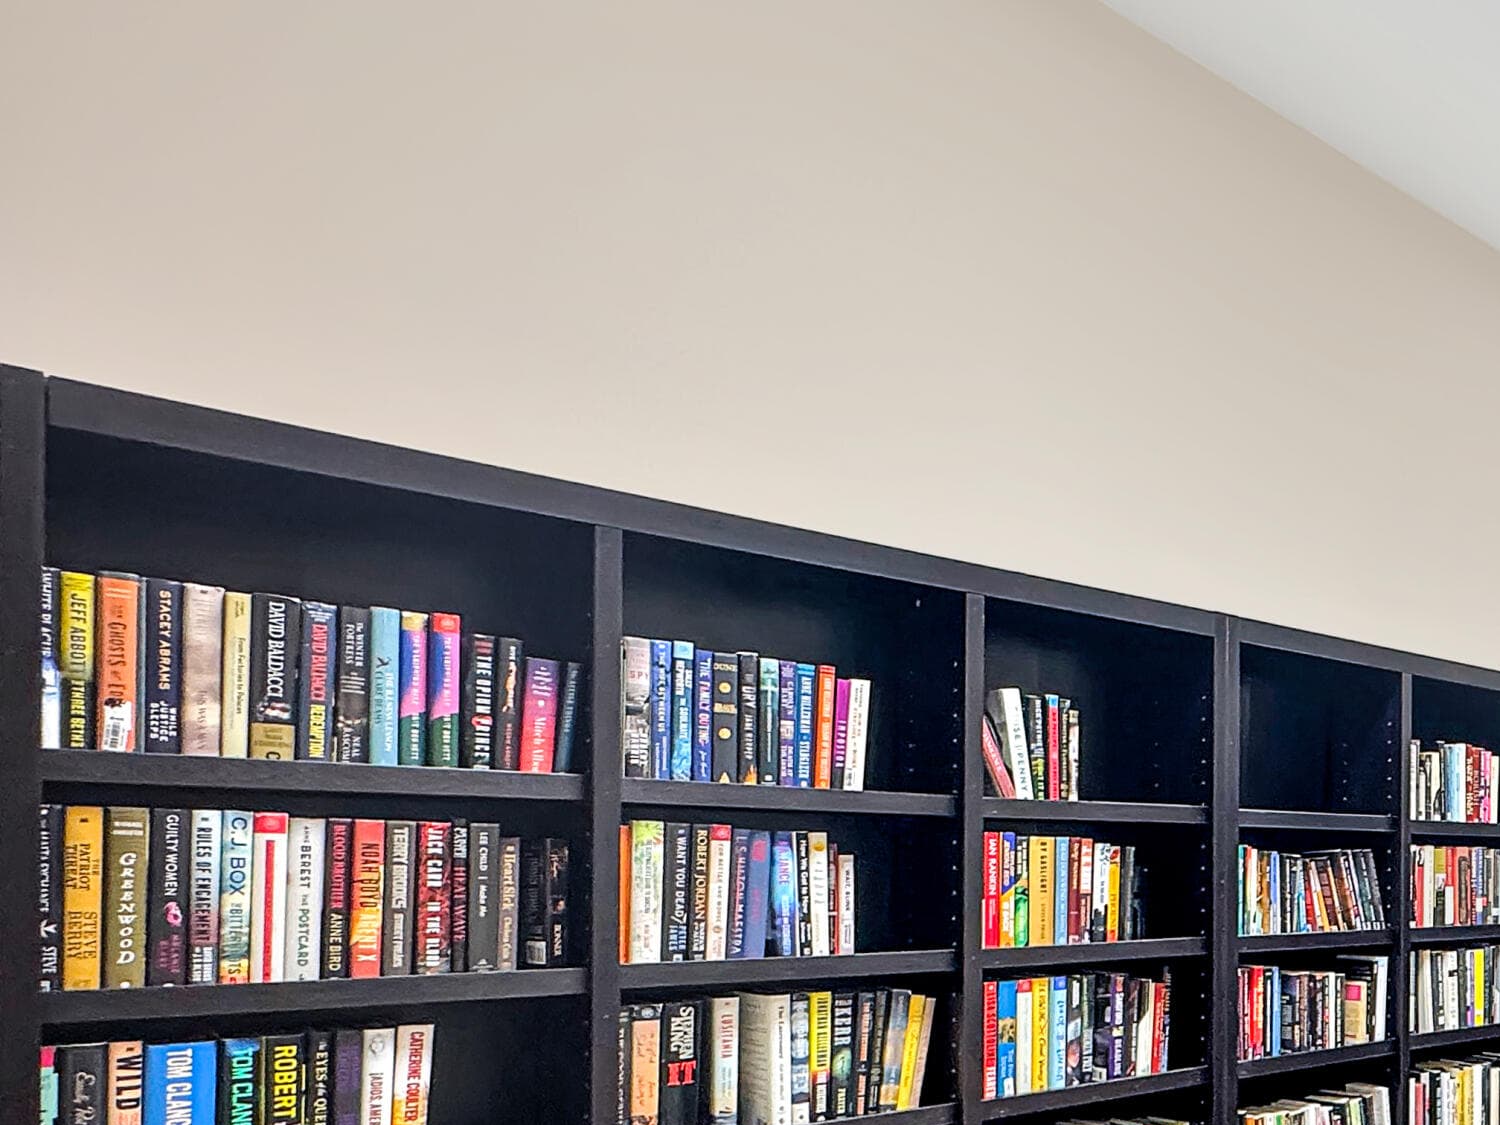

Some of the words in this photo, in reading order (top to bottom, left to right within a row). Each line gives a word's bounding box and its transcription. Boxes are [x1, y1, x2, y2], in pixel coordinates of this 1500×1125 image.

[72, 593, 87, 624] JEFF
[159, 590, 171, 637] STACEY
[269, 602, 285, 638] DAVID
[70, 627, 86, 675] ABBOTT
[108, 622, 126, 666] GHOSTS
[236, 638, 246, 652] From
[312, 624, 327, 652] DAVID
[345, 624, 354, 664] FORTRESS
[355, 633, 364, 666] WINTER
[159, 640, 171, 689] ABRAMS
[236, 655, 245, 682] Factories
[267, 640, 283, 697] BALDACCI
[477, 656, 491, 674] THE
[658, 652, 666, 664] THE
[699, 658, 711, 677] THE
[312, 655, 327, 700] BALDACCI
[801, 676, 812, 694] ANNE
[71, 686, 85, 714] THREE
[236, 692, 244, 714] Palaces
[476, 679, 491, 713] OPIUM
[698, 681, 710, 711] FAMILY
[741, 686, 755, 708] DRY
[150, 703, 159, 739] SLEEPS
[159, 701, 168, 741] JUSTICE
[311, 705, 325, 757] REDEMPTION
[474, 716, 491, 757] PRINCE
[533, 717, 548, 744] Mitch
[658, 722, 664, 732] US
[698, 713, 710, 745] OUTING
[744, 715, 753, 731] JANE
[743, 733, 753, 760] HARPER
[1017, 753, 1027, 791] PENNY
[166, 815, 179, 851] GUILTY
[197, 827, 212, 857] RULES
[333, 824, 346, 859] BLOOD
[393, 827, 408, 862] TERRY
[427, 828, 441, 854] JACK
[480, 832, 488, 844] LEE
[1040, 842, 1047, 851] BY
[66, 845, 78, 889] THREAT
[80, 843, 91, 890] PATRIOT
[197, 862, 211, 873] OF
[300, 845, 311, 888] BEREST
[361, 843, 380, 873] NOAH
[479, 848, 487, 871] CHILD
[677, 837, 686, 866] WANT
[696, 830, 708, 872] ROBERT
[164, 854, 178, 896] WOMEN
[230, 857, 246, 896] BOX
[331, 862, 346, 908] BROTHER
[392, 865, 407, 908] BROOKS
[427, 860, 441, 887] CARR
[453, 867, 466, 898] HEAT
[676, 868, 686, 887] YOU
[778, 857, 789, 885] JANCE
[117, 852, 137, 964] GREENWOOD
[197, 878, 211, 941] ENGAGEMENT
[360, 879, 379, 907] BOYD
[675, 891, 685, 917] DEAD
[694, 873, 706, 920] JORDAN
[67, 911, 82, 959] BERRY
[82, 912, 98, 959] STEVE
[298, 909, 310, 966] POSTCARD
[330, 913, 342, 942] ANNE
[358, 914, 377, 949] AGENT
[426, 917, 440, 933] THE
[453, 905, 465, 941] WAVE
[730, 904, 744, 954] MAESTRA
[42, 947, 56, 973] STEVE
[328, 946, 340, 970] BIRD
[425, 938, 440, 966] BLOOD
[817, 997, 829, 1029] JONATHAN
[986, 991, 995, 1012] LISA
[670, 1017, 684, 1052] KING
[679, 1006, 695, 1060] STEPHEN
[721, 1014, 733, 1059] LUSITANIA
[834, 1007, 852, 1046] KERR
[166, 1049, 192, 1078] TOM
[231, 1048, 253, 1078] TOM
[316, 1052, 328, 1081] EYES
[408, 1031, 424, 1079] CATHERINE
[816, 1032, 827, 1067] KELLERMAN
[116, 1055, 140, 1110] WILD
[274, 1045, 297, 1118] ROBERT
[405, 1083, 420, 1121] COULTER
